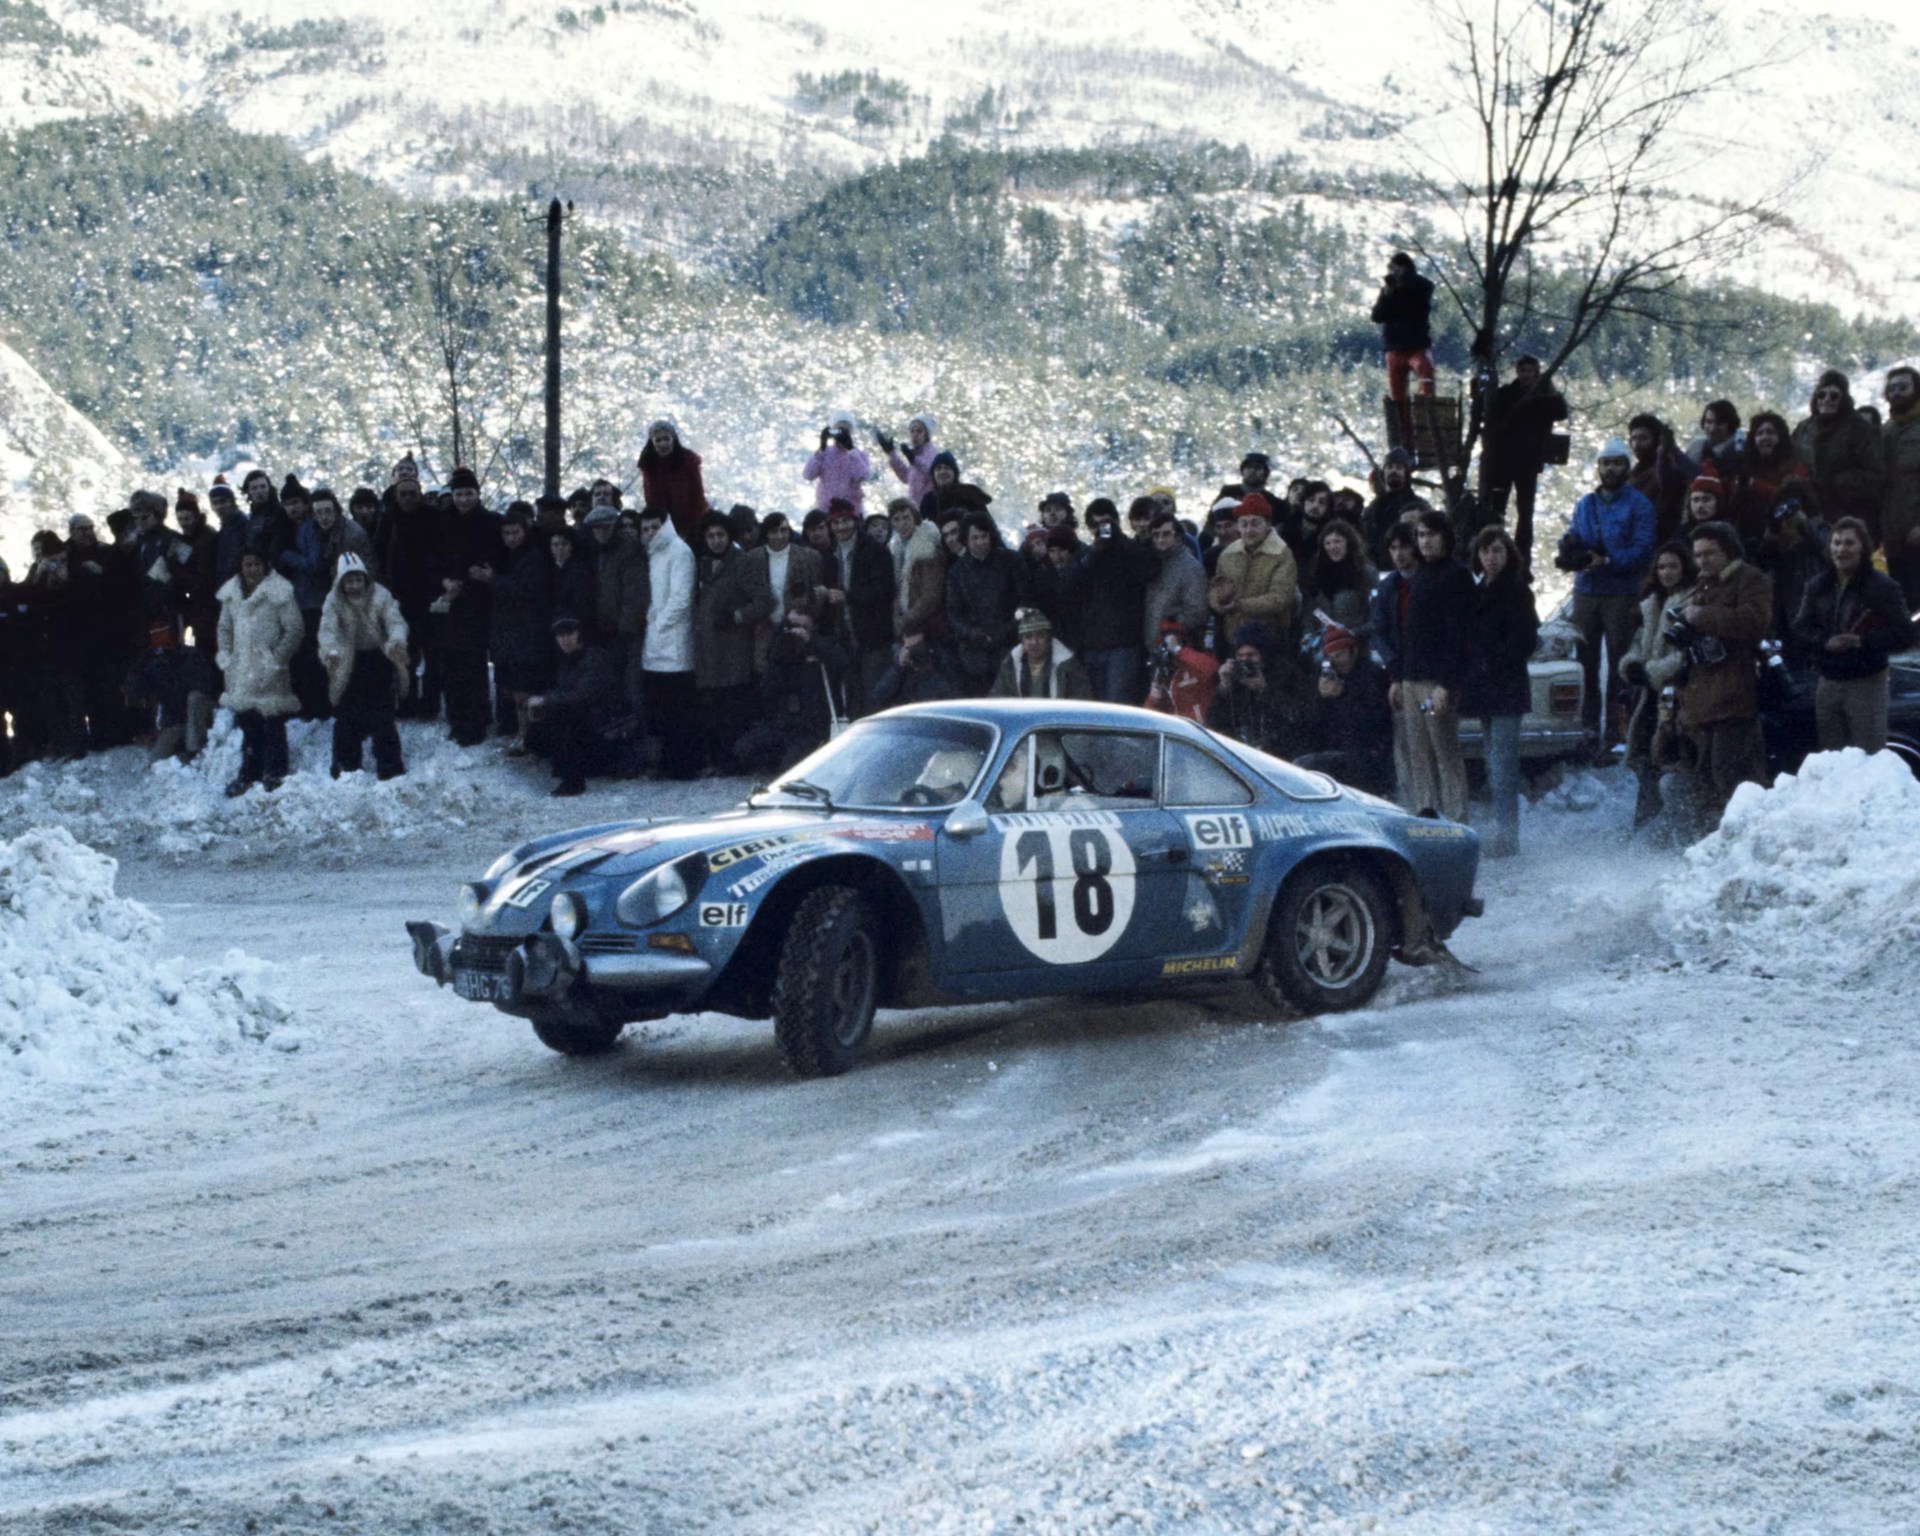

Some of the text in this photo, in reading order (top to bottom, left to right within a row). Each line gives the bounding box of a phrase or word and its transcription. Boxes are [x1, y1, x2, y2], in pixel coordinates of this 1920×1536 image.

[1194, 815, 1244, 845] elf
[1256, 813, 1316, 840] ALPINE
[1015, 828, 1115, 939] 18
[702, 904, 746, 926] elf
[1162, 956, 1237, 974] MICHELIN
